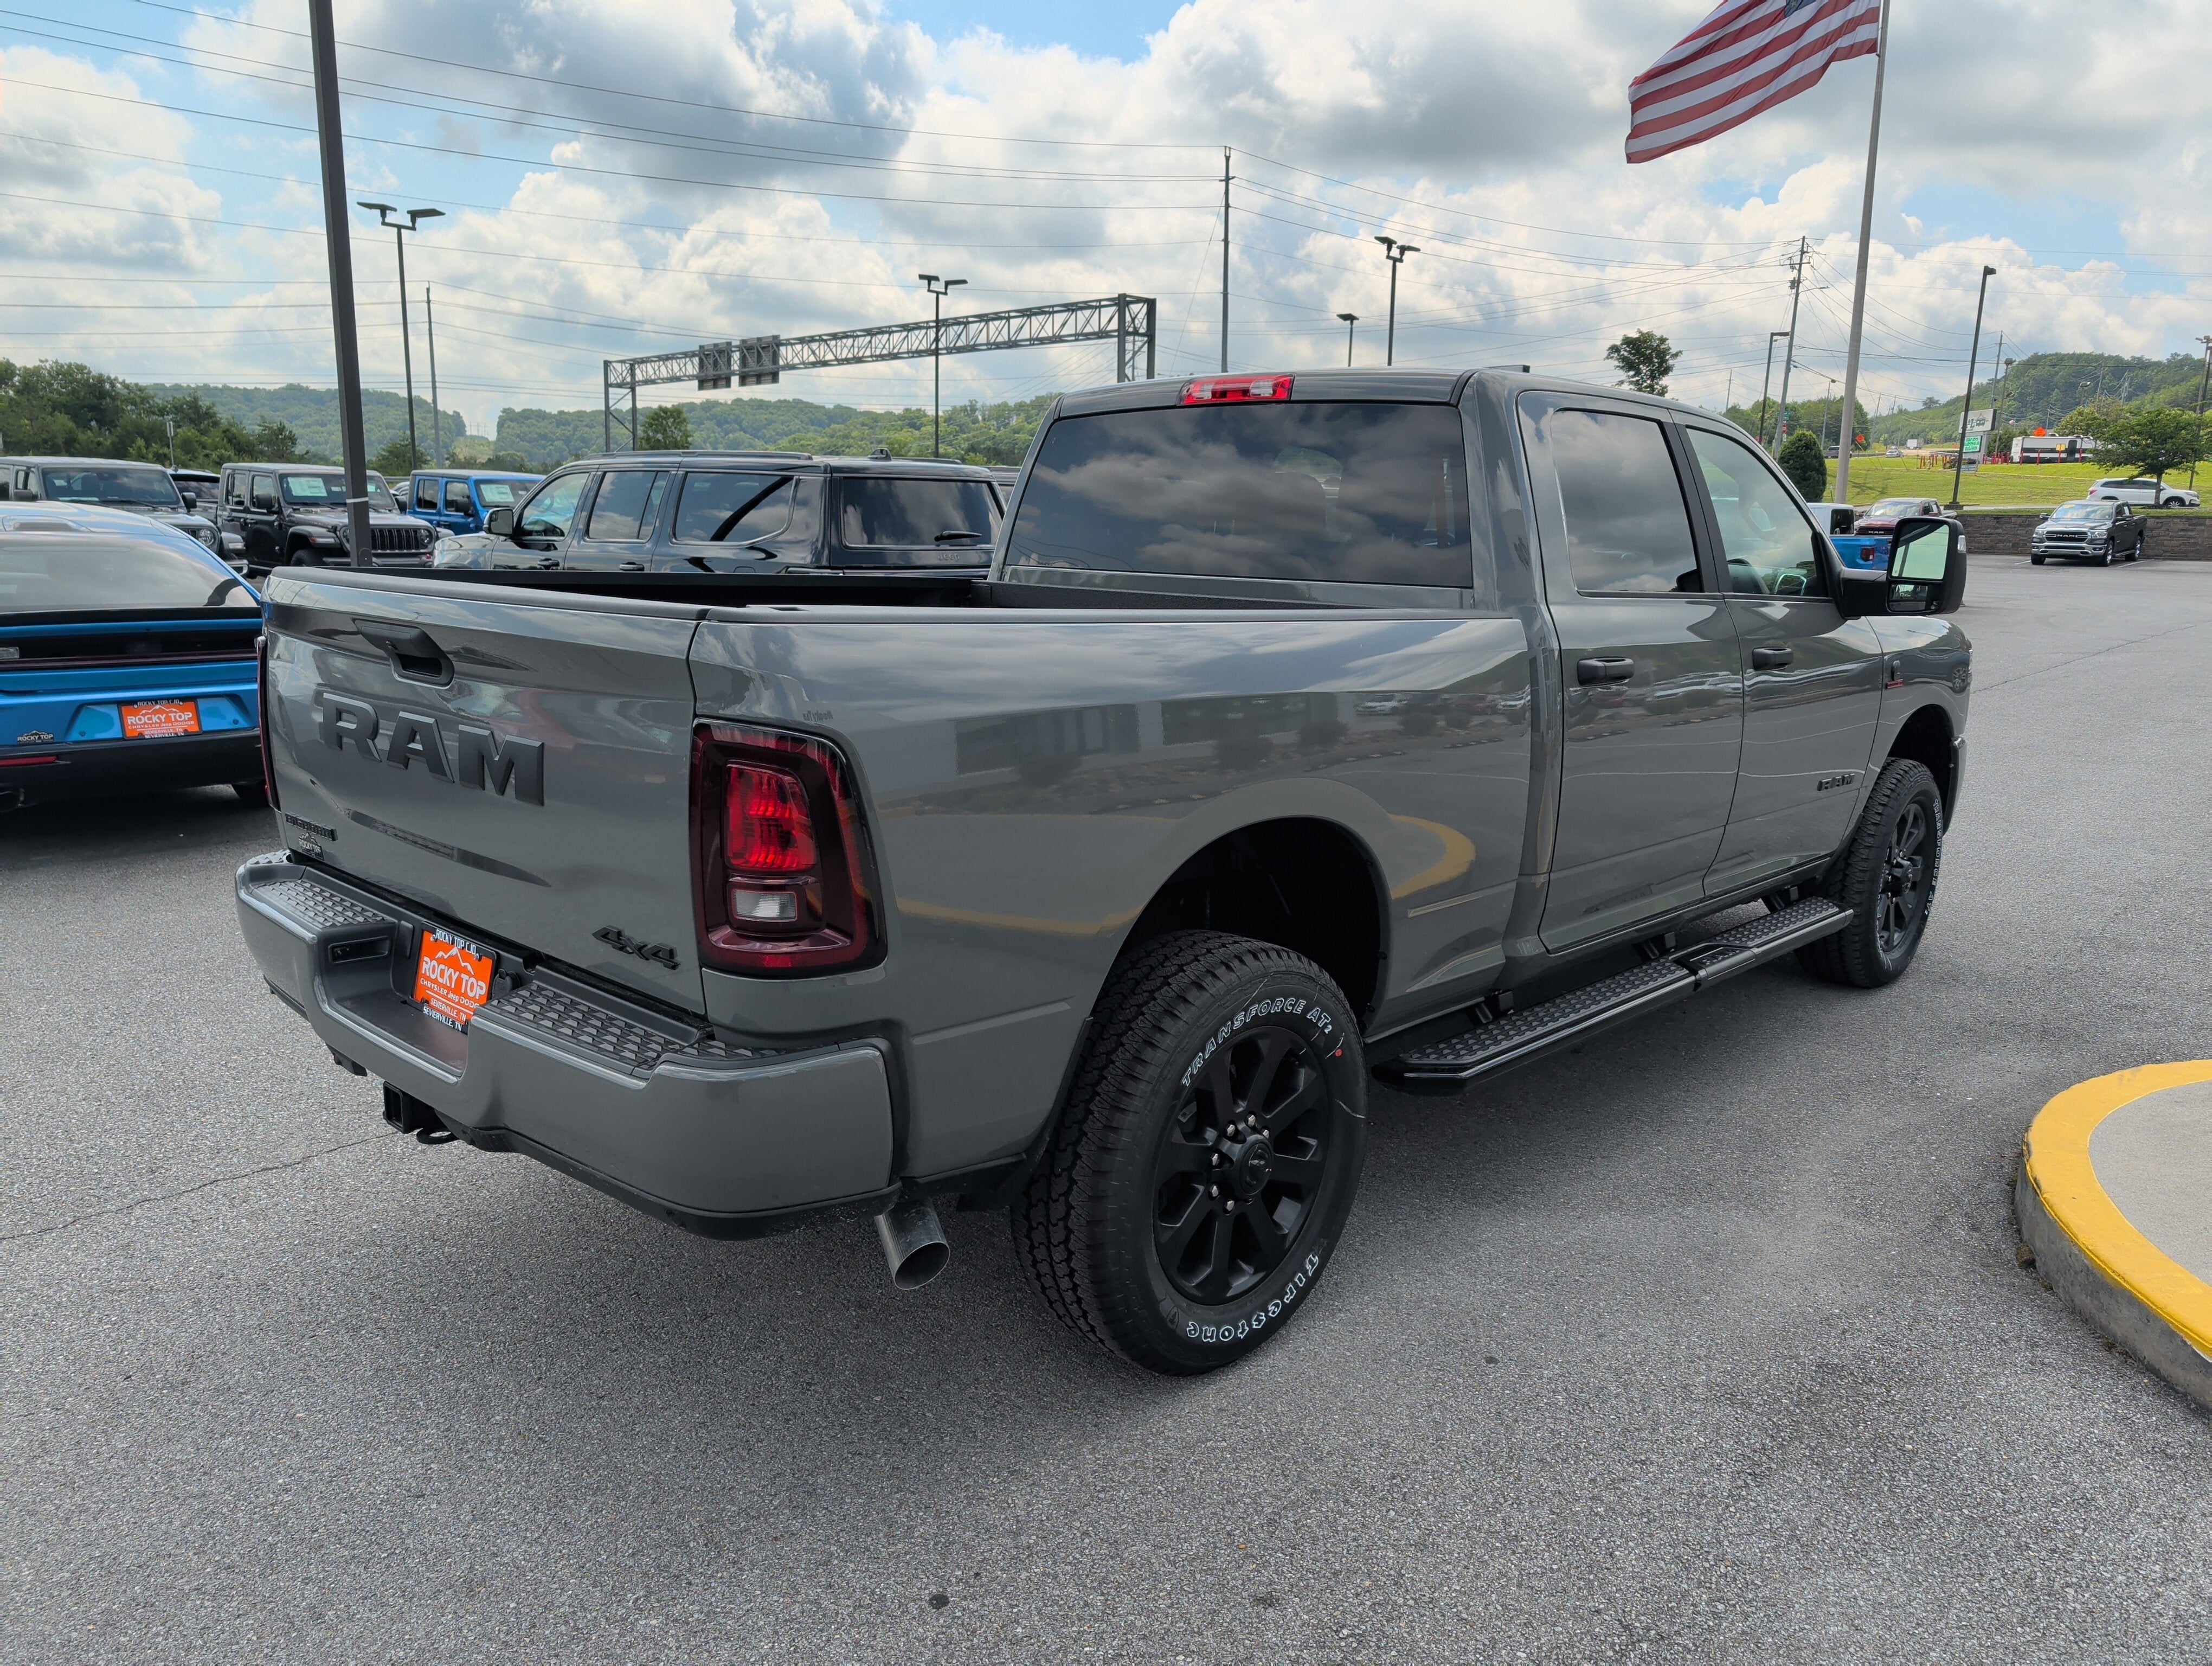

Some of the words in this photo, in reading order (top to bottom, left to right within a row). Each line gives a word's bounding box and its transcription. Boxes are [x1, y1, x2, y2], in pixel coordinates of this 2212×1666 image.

[127, 714, 166, 725] ROCKY
[169, 712, 192, 721] TOP
[323, 693, 544, 806] RAM
[1817, 773, 1855, 791] RAM
[1932, 798, 1943, 886] TRANSFORCE
[435, 929, 453, 945] ROCKY
[454, 937, 465, 950] TOP
[466, 942, 477, 955] CJD
[421, 956, 460, 989] ROCKY
[460, 973, 486, 999] TOP
[420, 978, 450, 996] CHRYSLER
[448, 990, 459, 1003] Jeep
[460, 996, 480, 1009] DODG
[423, 1006, 453, 1028] SEVIERVILLE,
[455, 1022, 462, 1031] TN
[430, 997, 458, 1018] SEVIERVILLE,
[460, 1013, 466, 1022] TN
[1181, 997, 1306, 1086] TRANSFORCE
